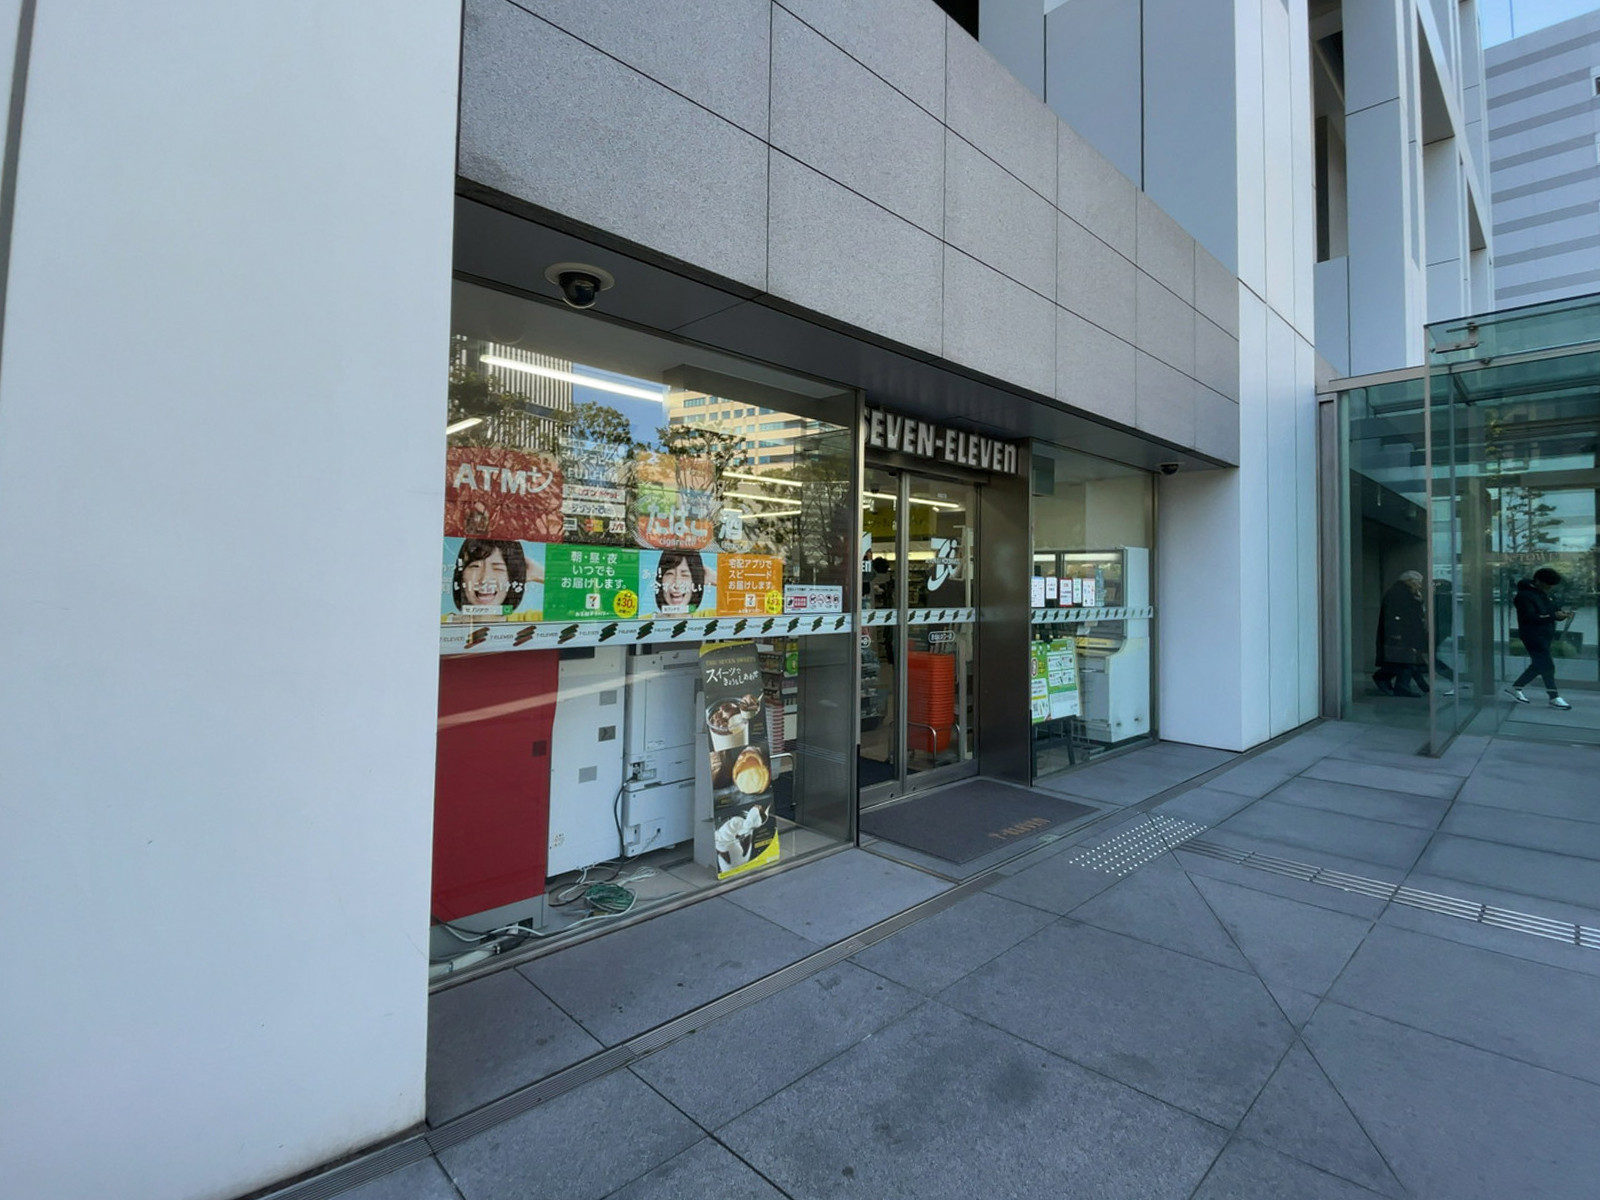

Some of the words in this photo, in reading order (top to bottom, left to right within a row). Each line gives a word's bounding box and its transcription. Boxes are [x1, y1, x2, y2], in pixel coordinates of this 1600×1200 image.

[571, 551, 618, 564] 朝・昼・夜
[572, 565, 615, 577] いつでも
[561, 577, 627, 589] お届けします。
